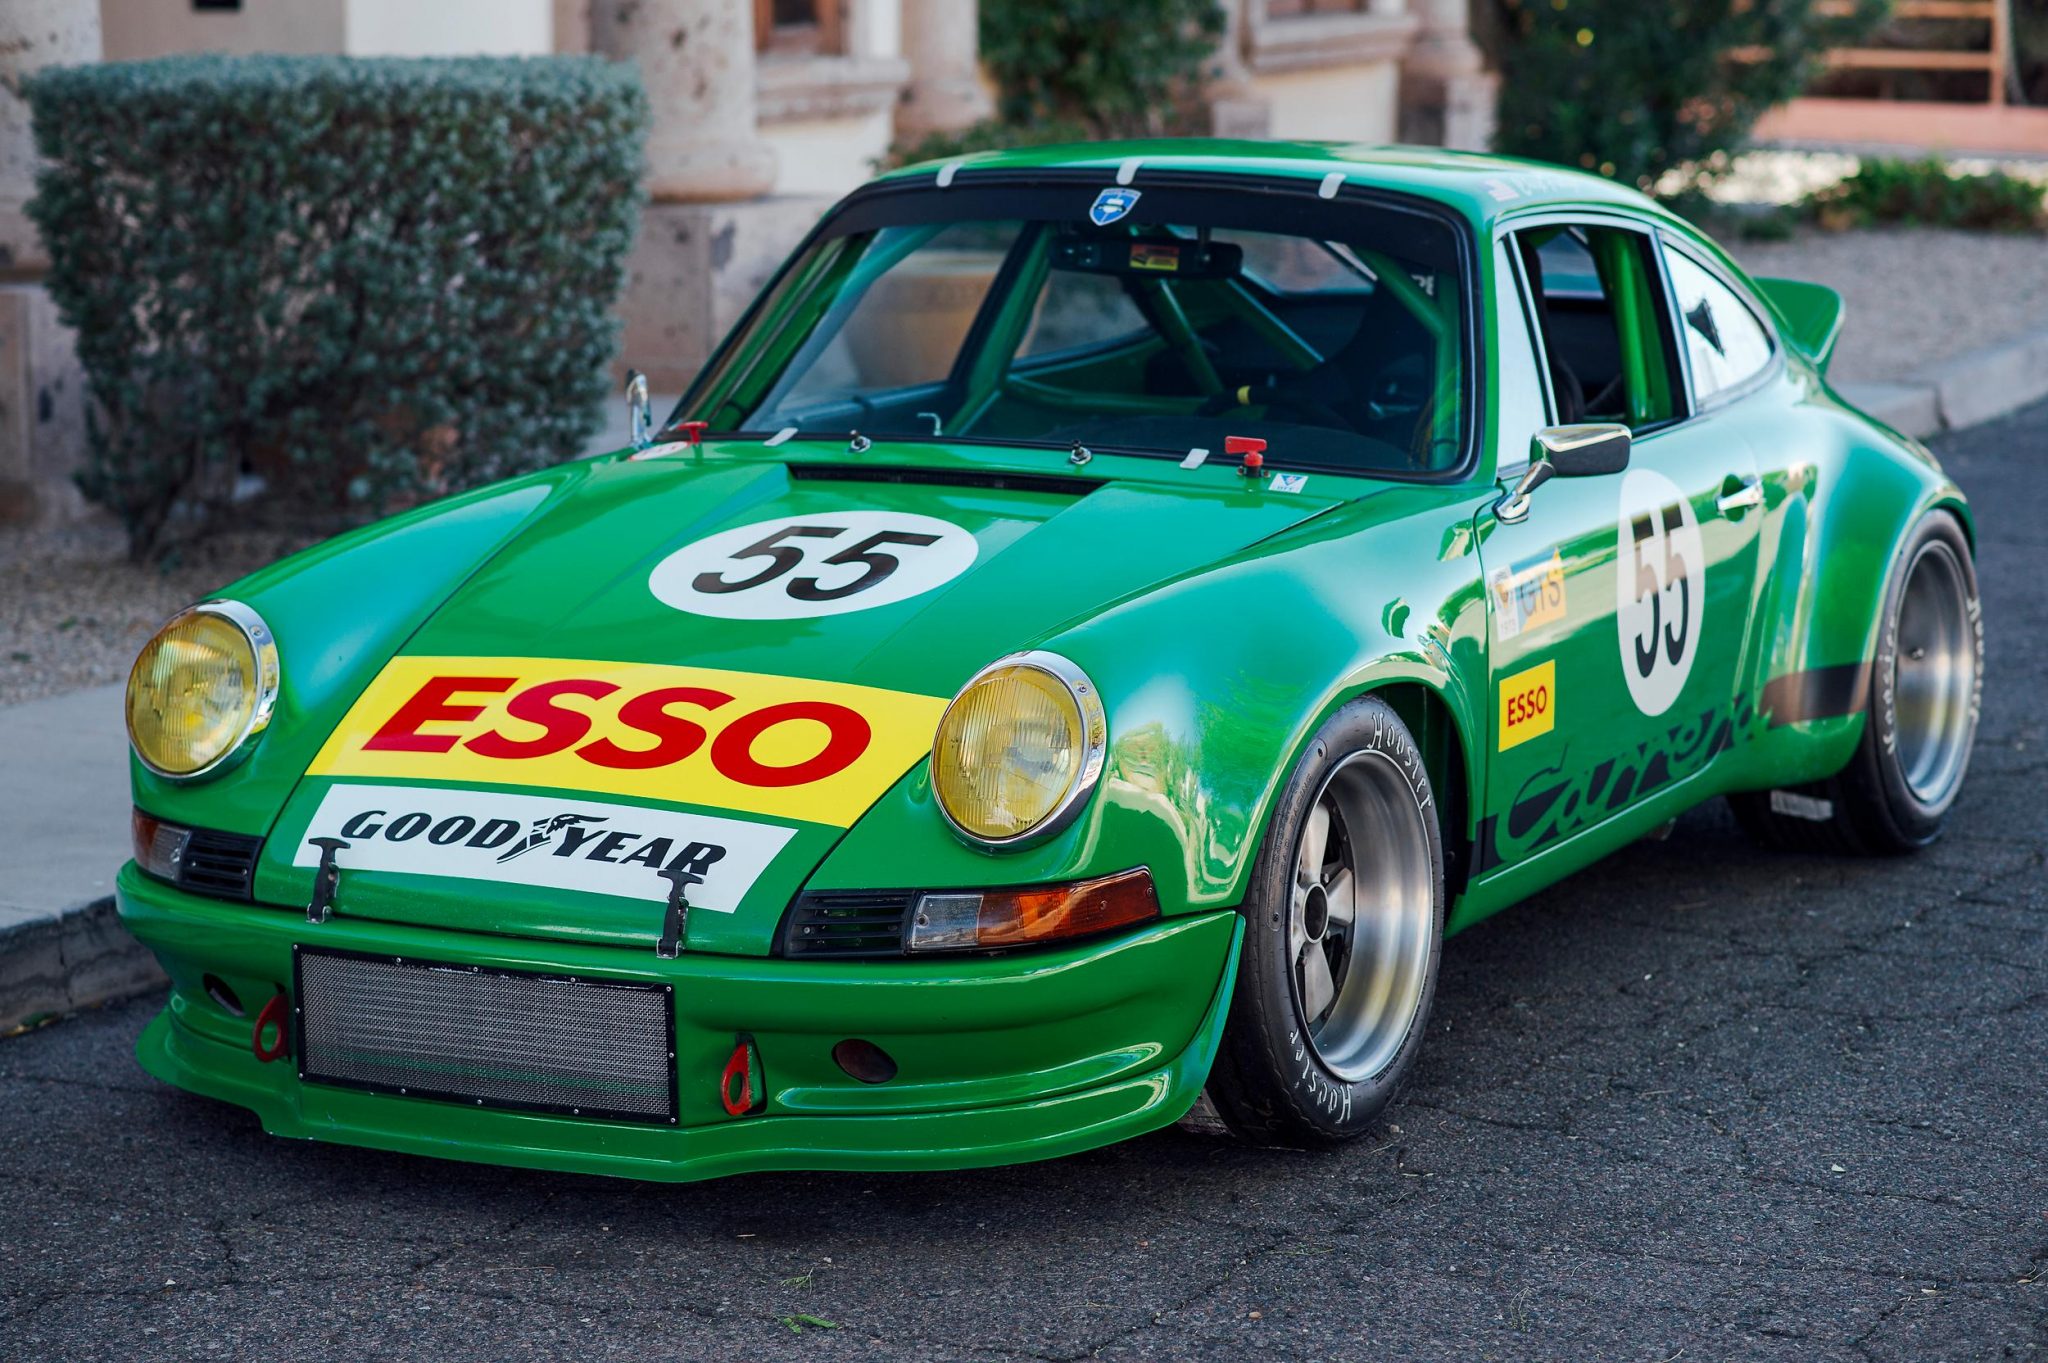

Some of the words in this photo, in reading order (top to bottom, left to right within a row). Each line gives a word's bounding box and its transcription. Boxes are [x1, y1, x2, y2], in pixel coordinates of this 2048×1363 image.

[692, 525, 944, 601] 55
[1630, 502, 1689, 678] 55
[360, 676, 872, 788] ESSO
[1507, 685, 1547, 727] ESSO
